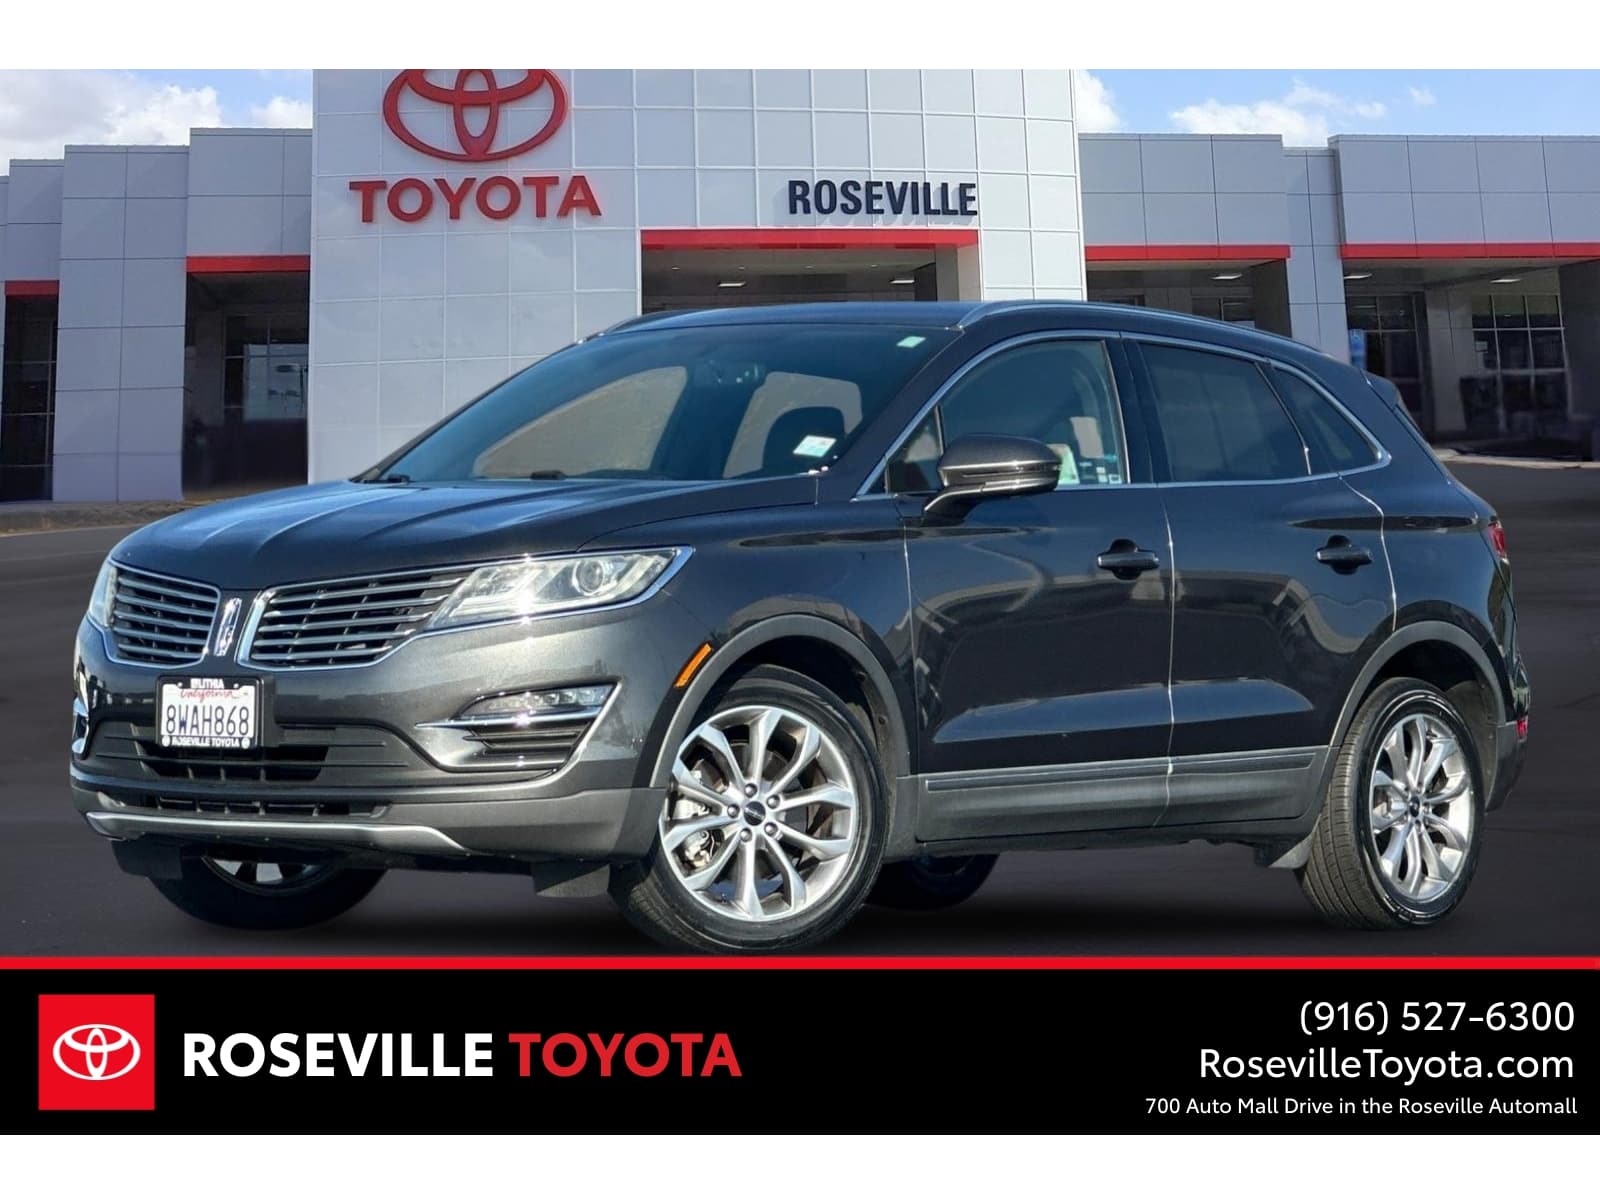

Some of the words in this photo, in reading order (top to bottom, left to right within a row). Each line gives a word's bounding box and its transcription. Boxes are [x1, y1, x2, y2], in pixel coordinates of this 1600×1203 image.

[349, 175, 602, 223] TOYOTA
[788, 179, 978, 216] ROSEVILLE
[165, 704, 249, 736] 8WAH868
